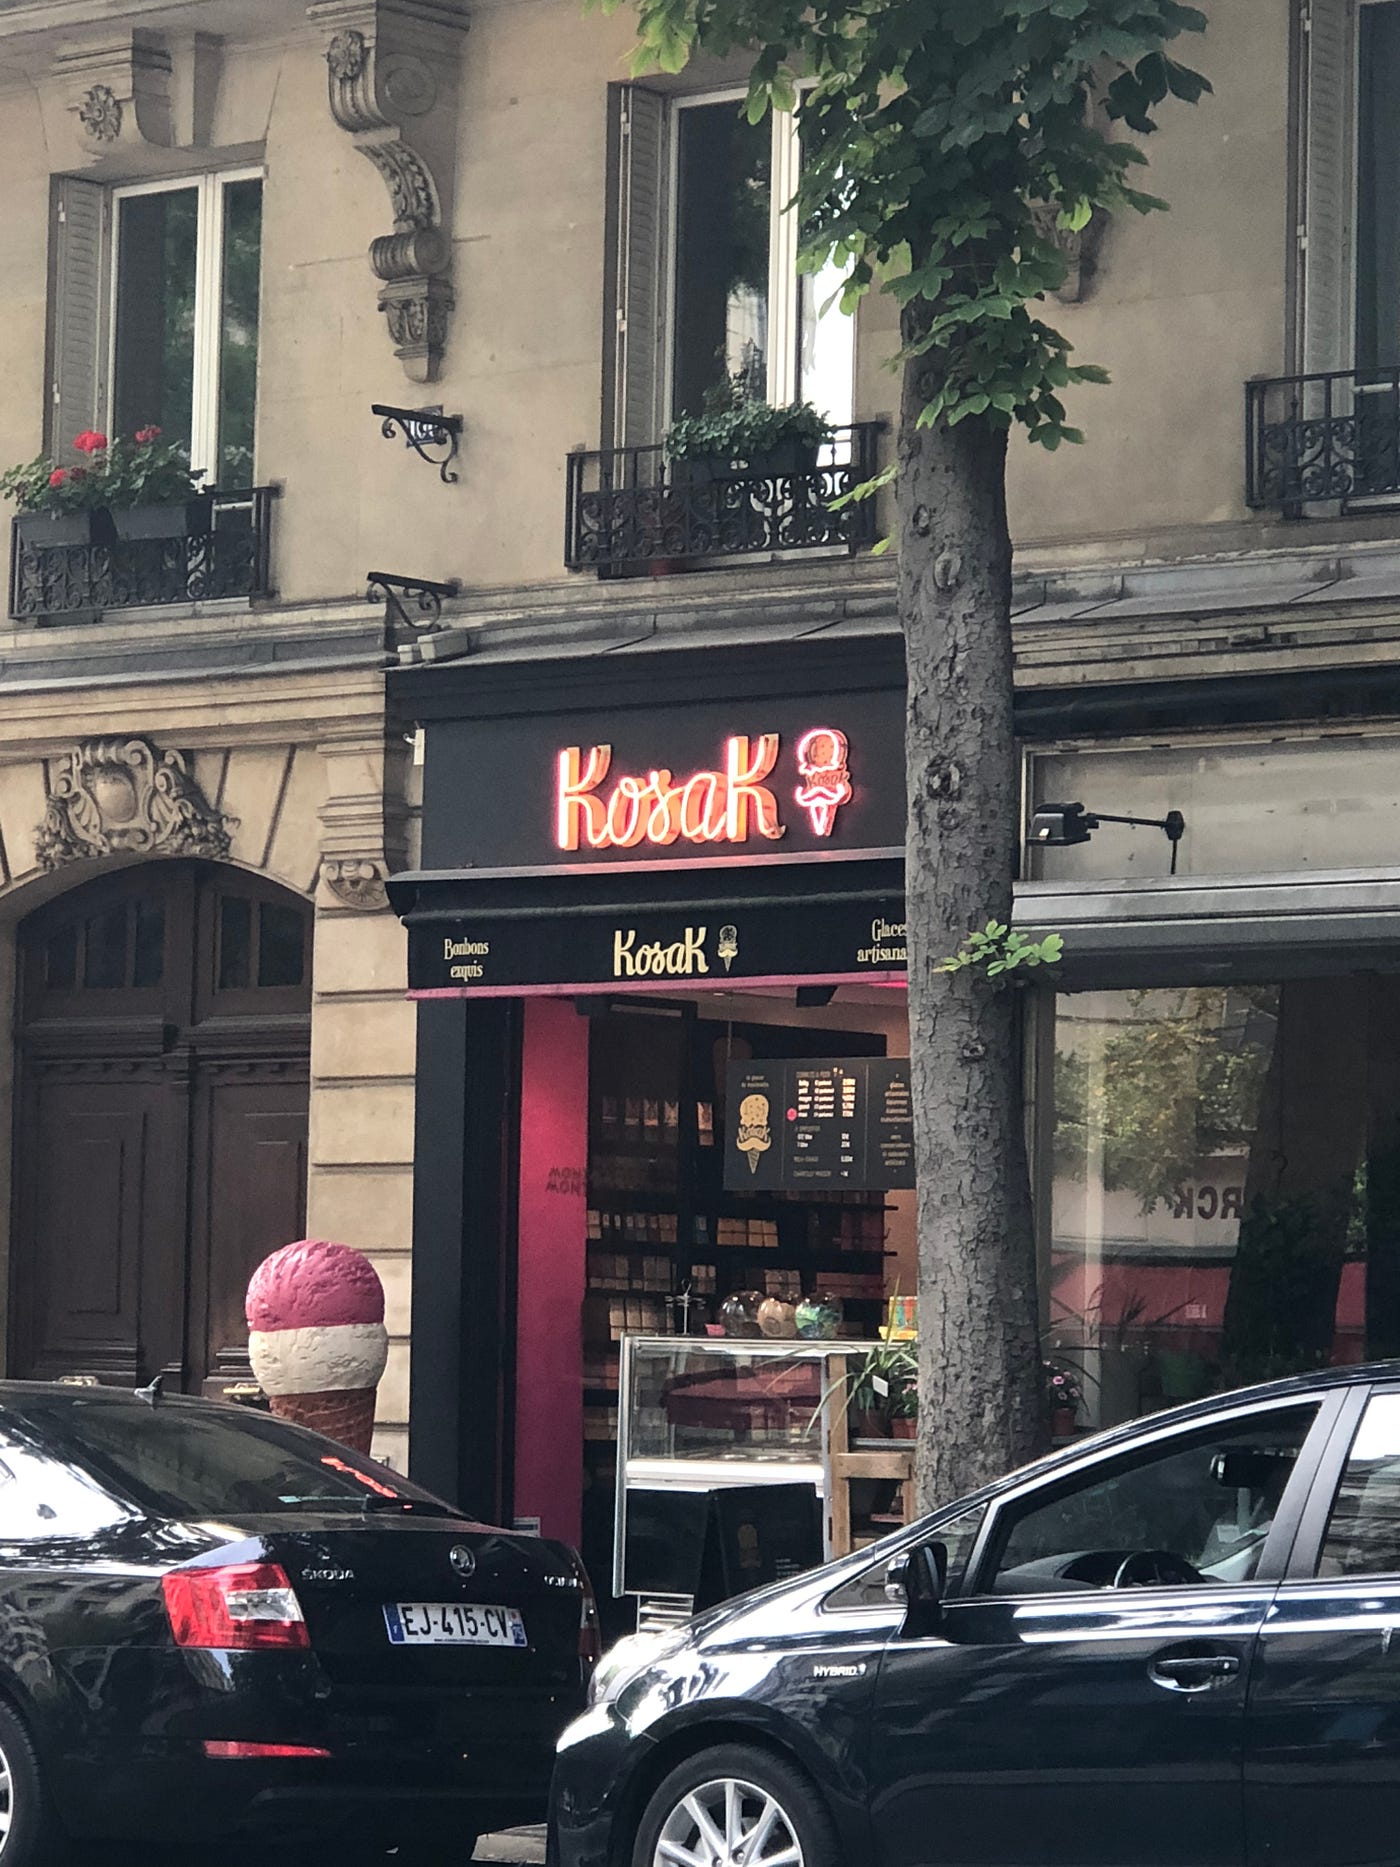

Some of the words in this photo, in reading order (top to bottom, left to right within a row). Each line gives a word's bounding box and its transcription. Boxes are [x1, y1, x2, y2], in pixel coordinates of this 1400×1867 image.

[444, 936, 489, 960] Bonbons
[856, 943, 908, 964] artisana
[450, 960, 484, 982] exquis
[401, 1606, 508, 1638] EJ-415-CV
[813, 1664, 858, 1677] HYBRID
